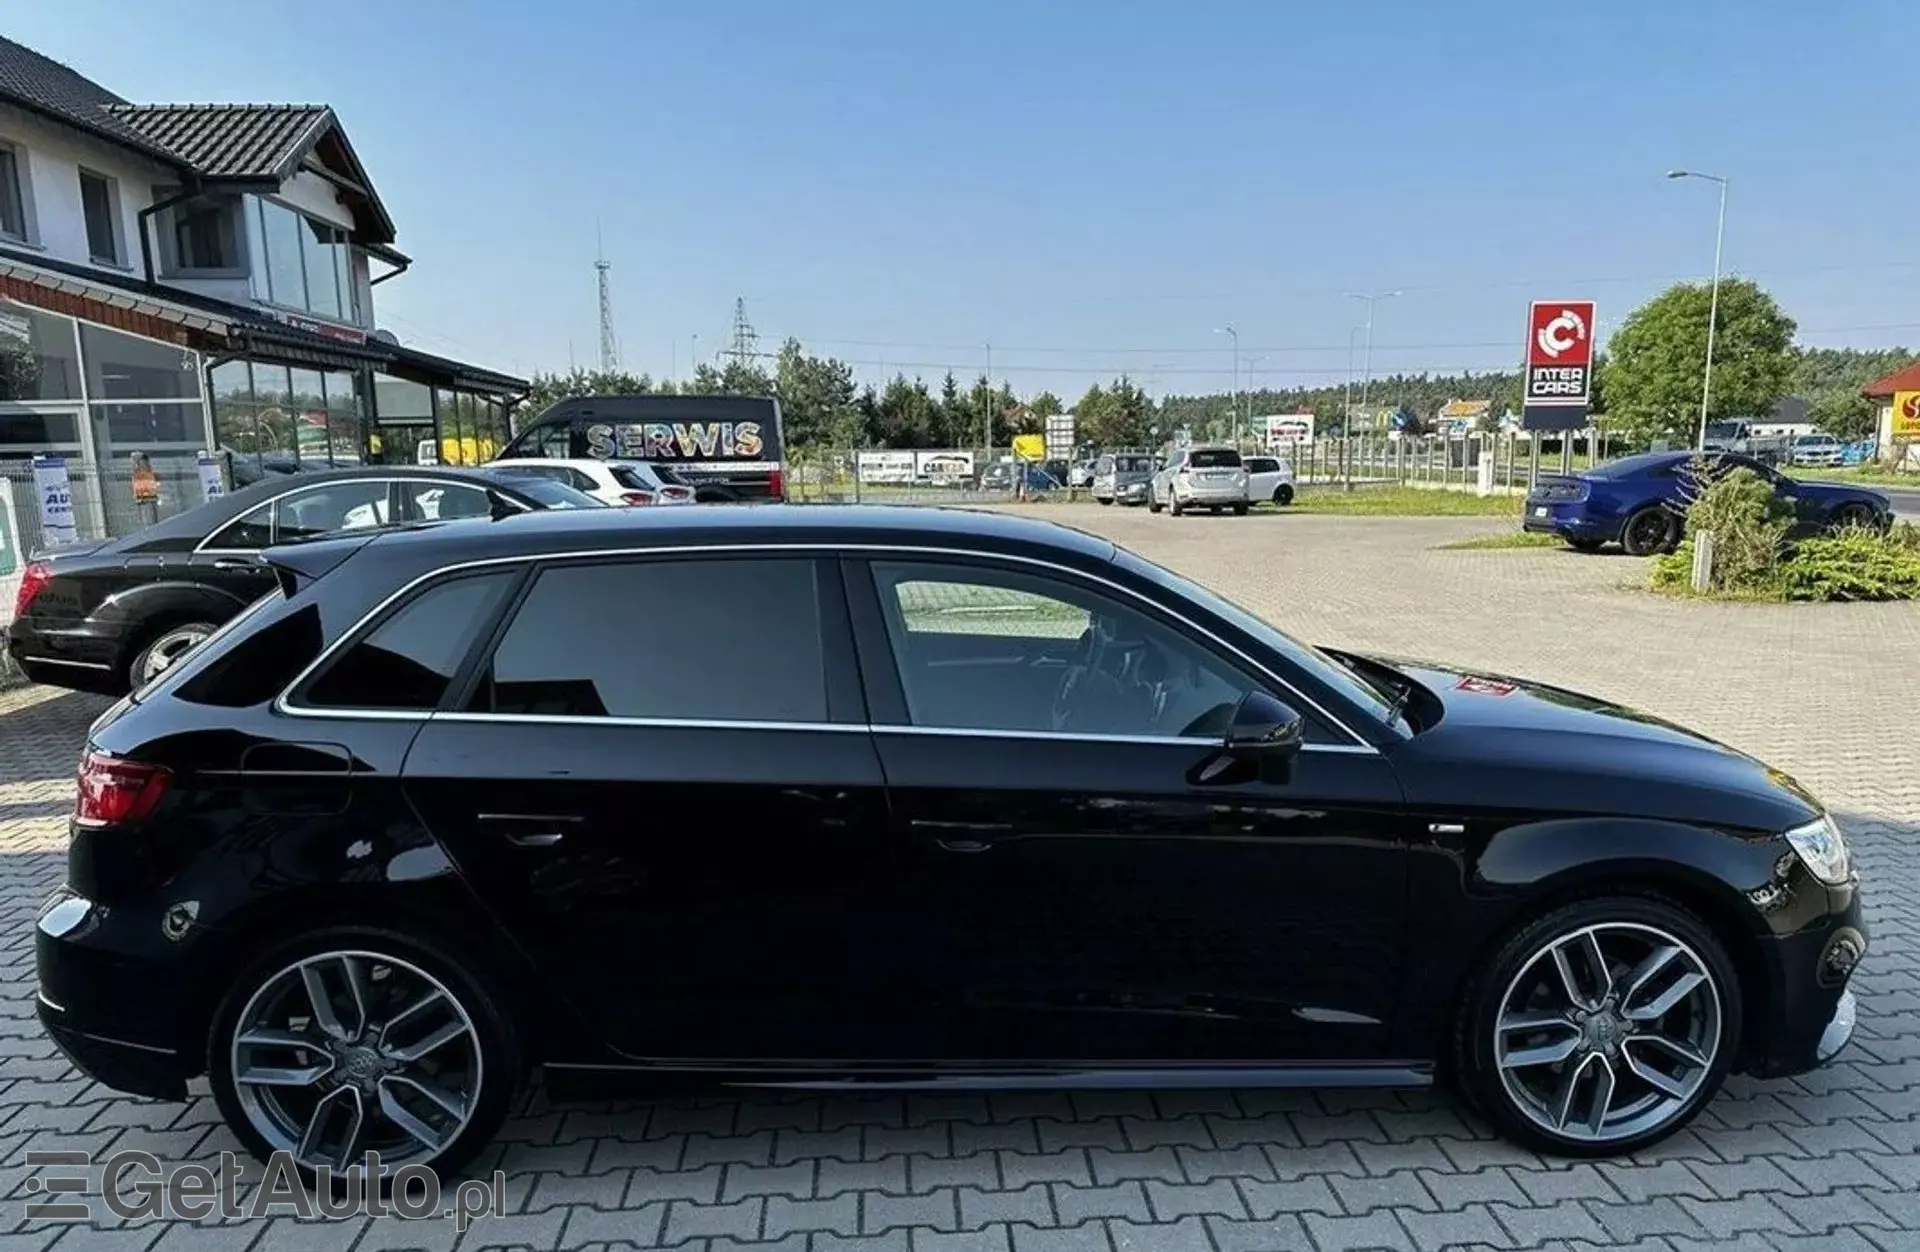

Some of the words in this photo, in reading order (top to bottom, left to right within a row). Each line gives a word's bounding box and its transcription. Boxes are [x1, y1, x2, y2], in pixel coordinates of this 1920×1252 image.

[1533, 367, 1584, 381] INTER
[1532, 381, 1583, 395] CARS
[586, 421, 763, 462] SERWIS
